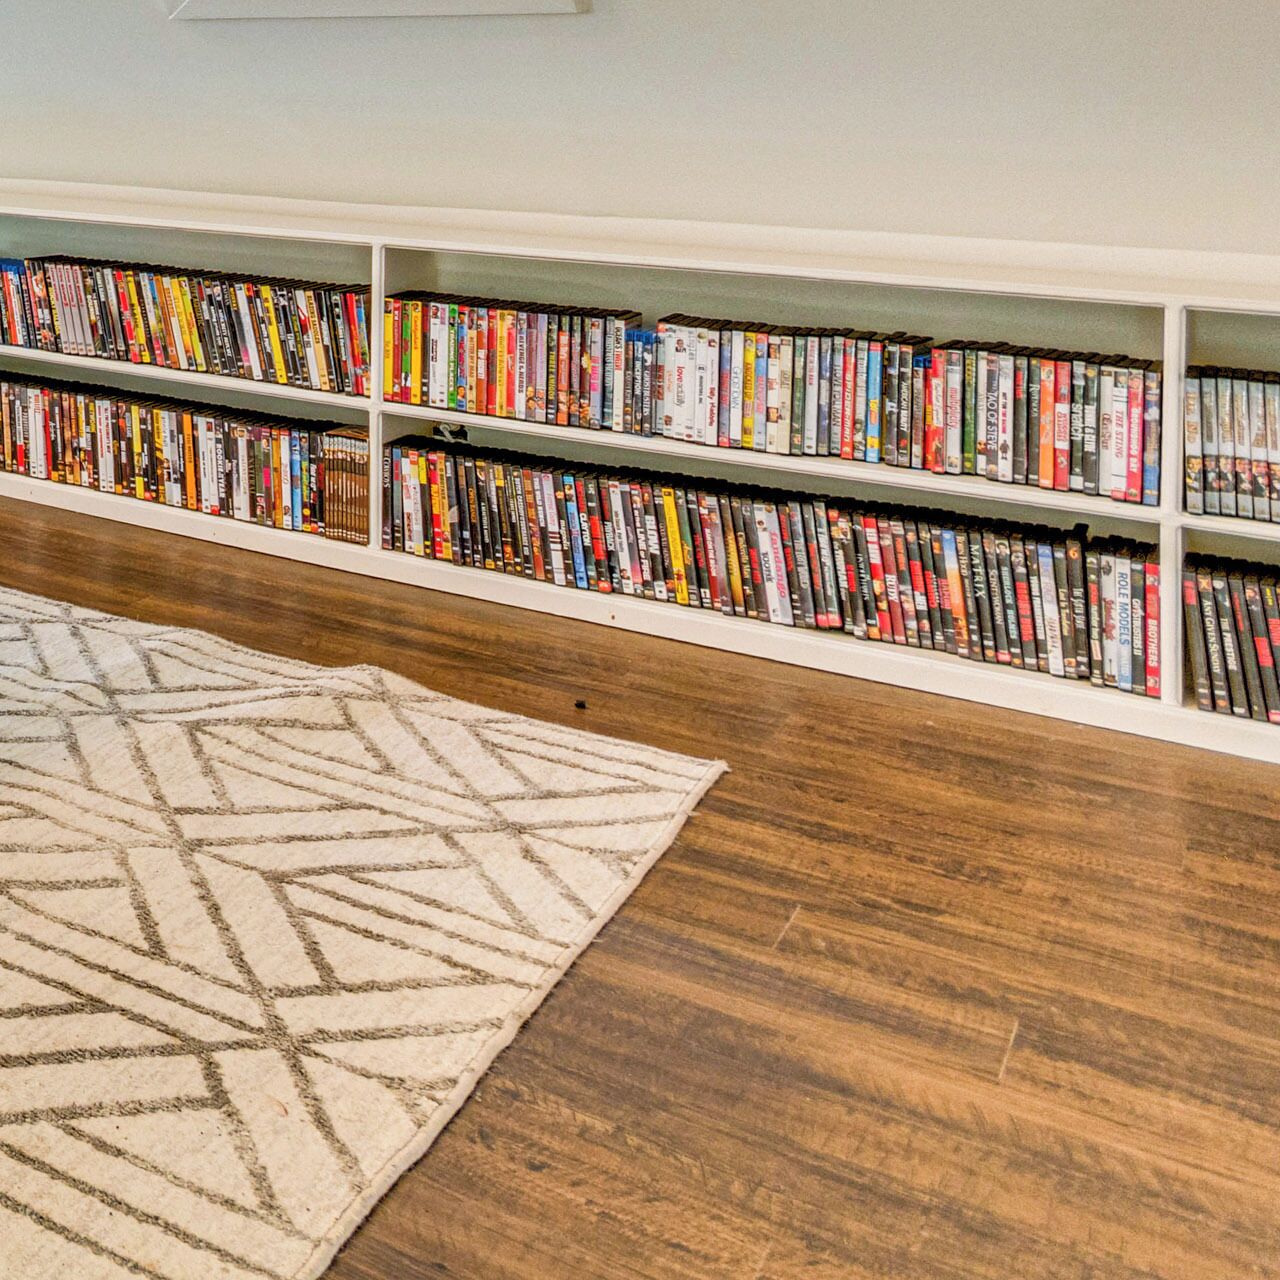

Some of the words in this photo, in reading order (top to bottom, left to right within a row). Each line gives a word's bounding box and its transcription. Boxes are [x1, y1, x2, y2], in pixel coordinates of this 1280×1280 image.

[675, 383, 684, 407] actually
[987, 392, 998, 409] TAO
[900, 411, 910, 432] BEAUTY
[988, 411, 998, 425] OF
[1071, 403, 1083, 440] snatch
[1115, 410, 1123, 429] THE
[988, 427, 997, 450] STEVE
[1115, 431, 1123, 458] STING
[559, 520, 568, 550] magnolia
[580, 513, 590, 545] CLAYTON
[604, 522, 615, 550] PAYBACK
[637, 528, 646, 550] LINE
[645, 515, 659, 555] BLOW
[641, 559, 651, 580] FIRE
[770, 531, 786, 598] fandango
[970, 545, 985, 598] MATRIX
[885, 574, 898, 602] RUDY
[989, 569, 997, 590] SCENT
[1118, 572, 1128, 598] ROLE
[991, 596, 1002, 625] WOMAN
[1001, 567, 1013, 604] SHERLOCK
[1008, 610, 1017, 639] HOLMES
[1203, 600, 1212, 617] ANY
[1119, 602, 1130, 645] MODELS
[1205, 618, 1216, 644] GIVEN
[1148, 619, 1157, 667] BROTHERS
[1223, 632, 1237, 671] PRESTIGE
[1209, 644, 1221, 674] SUNDAY
